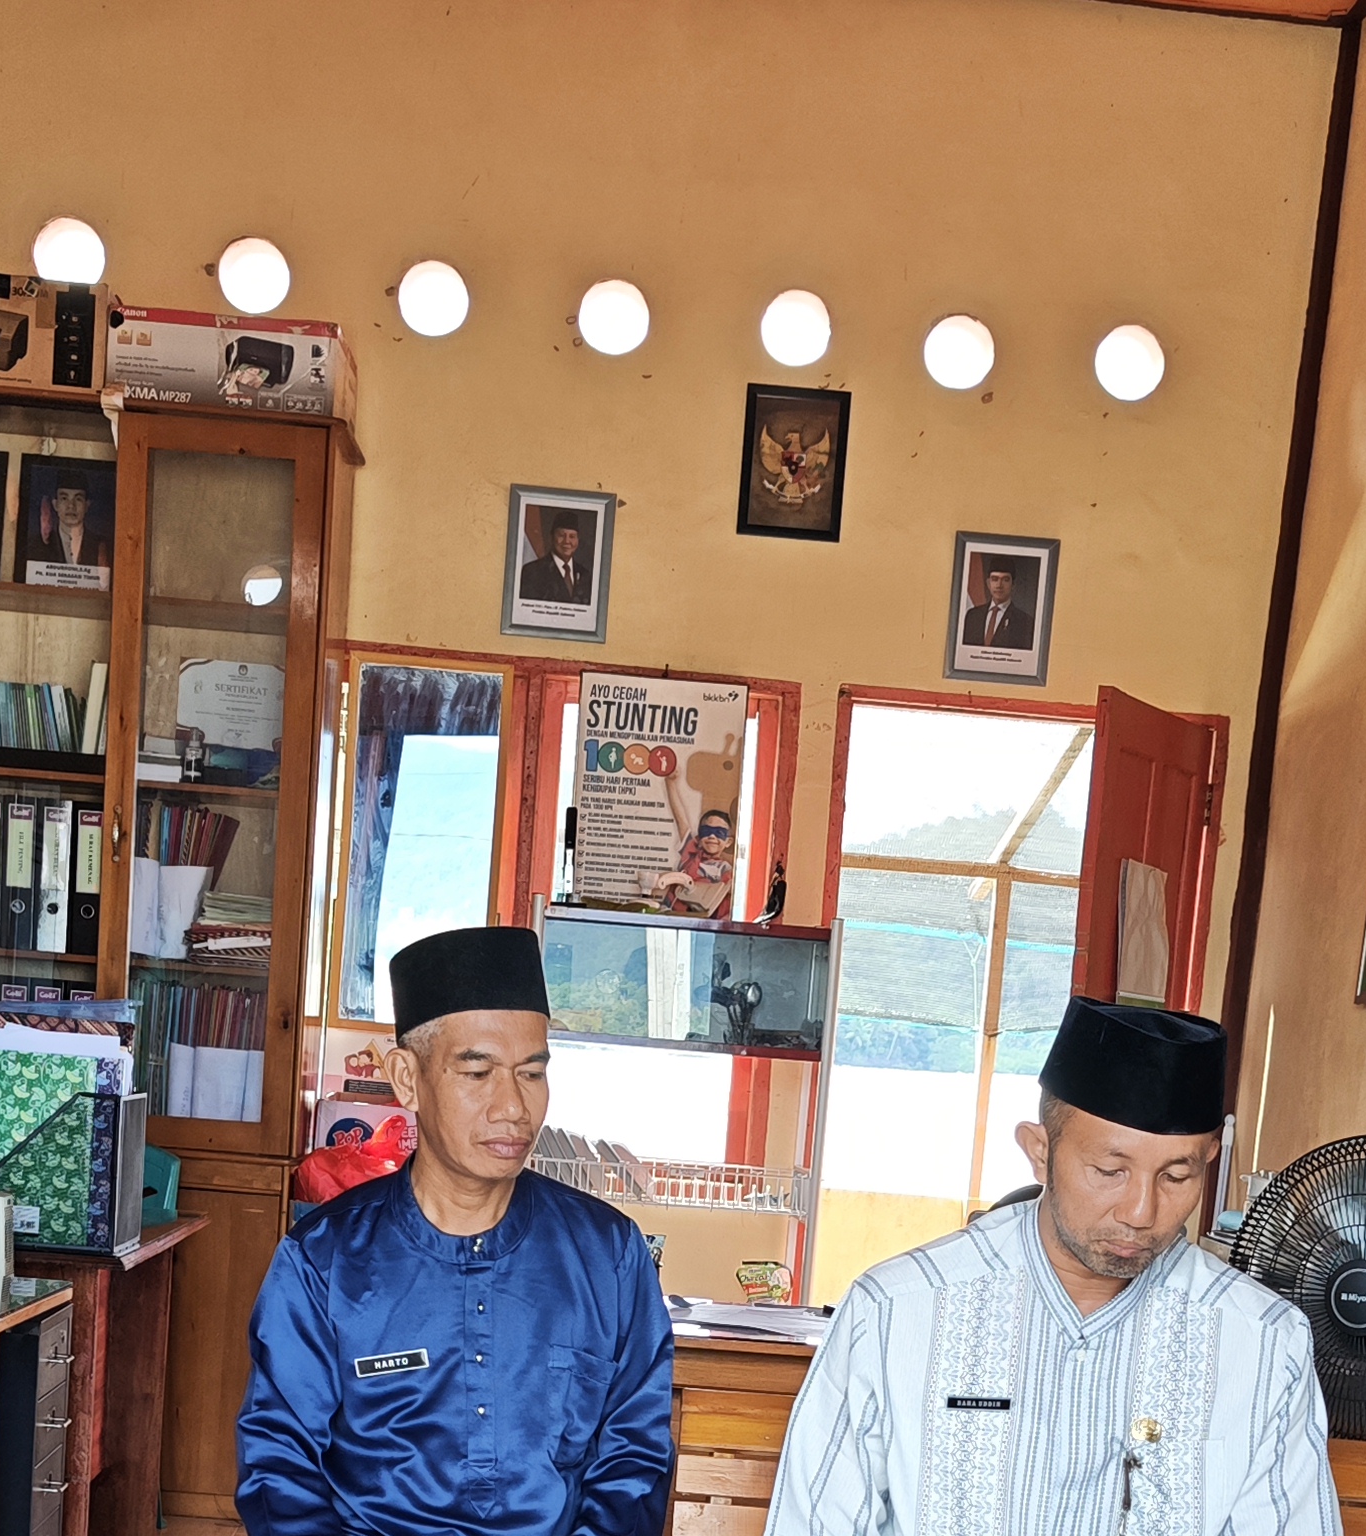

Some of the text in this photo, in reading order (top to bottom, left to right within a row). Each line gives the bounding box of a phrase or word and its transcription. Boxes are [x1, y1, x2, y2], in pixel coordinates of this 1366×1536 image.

[159, 390, 192, 404] MP287
[214, 683, 269, 697] SERTIFIKAT
[590, 684, 647, 702] AYO CEGAH
[702, 692, 730, 704] bkkbn
[586, 699, 699, 737] STUNTING
[586, 728, 695, 745] DENGAN MENGOPTIMALKAN PENGASUHAN
[583, 774, 651, 788] SERIBU HARI PERTAMA
[582, 783, 636, 796] KEHIDUPAN (HPK)
